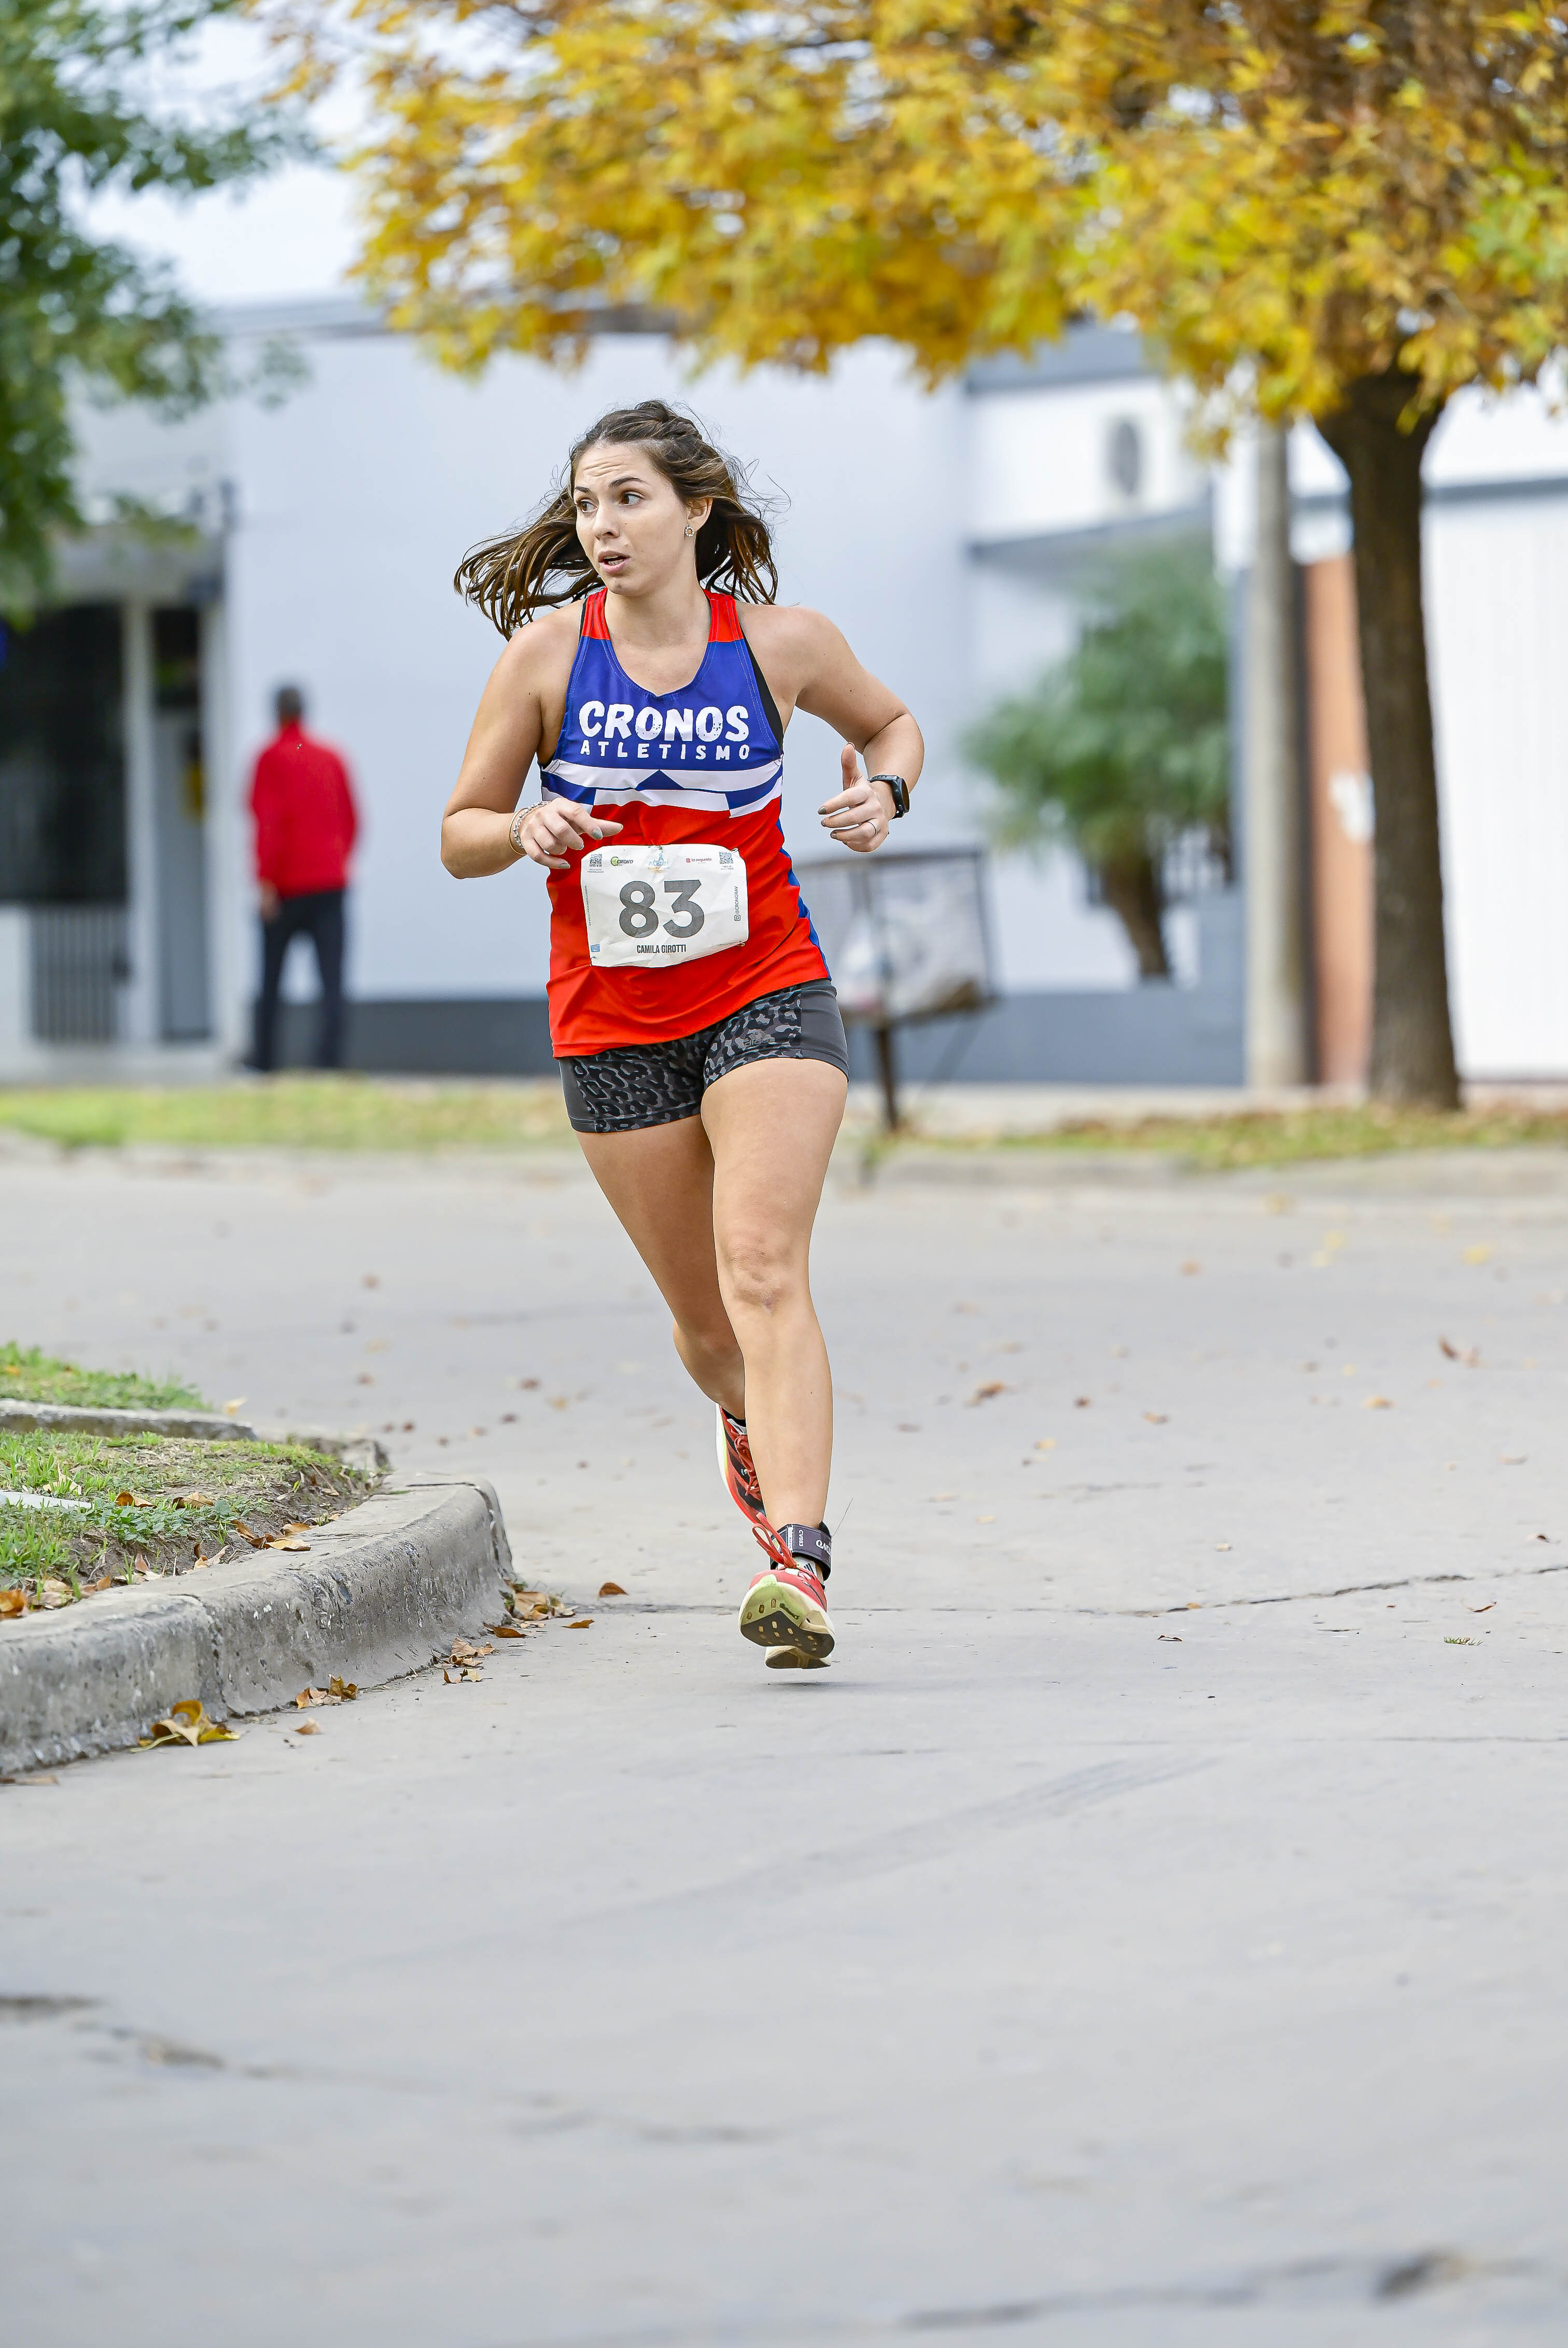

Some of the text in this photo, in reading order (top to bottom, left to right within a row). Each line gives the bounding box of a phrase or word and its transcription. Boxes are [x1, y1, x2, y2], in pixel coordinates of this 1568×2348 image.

[579, 700, 750, 742] CRONOS
[580, 739, 750, 760] ATLETISMO
[619, 879, 705, 938] 83
[637, 944, 686, 953] CAMILA GIROTTI
